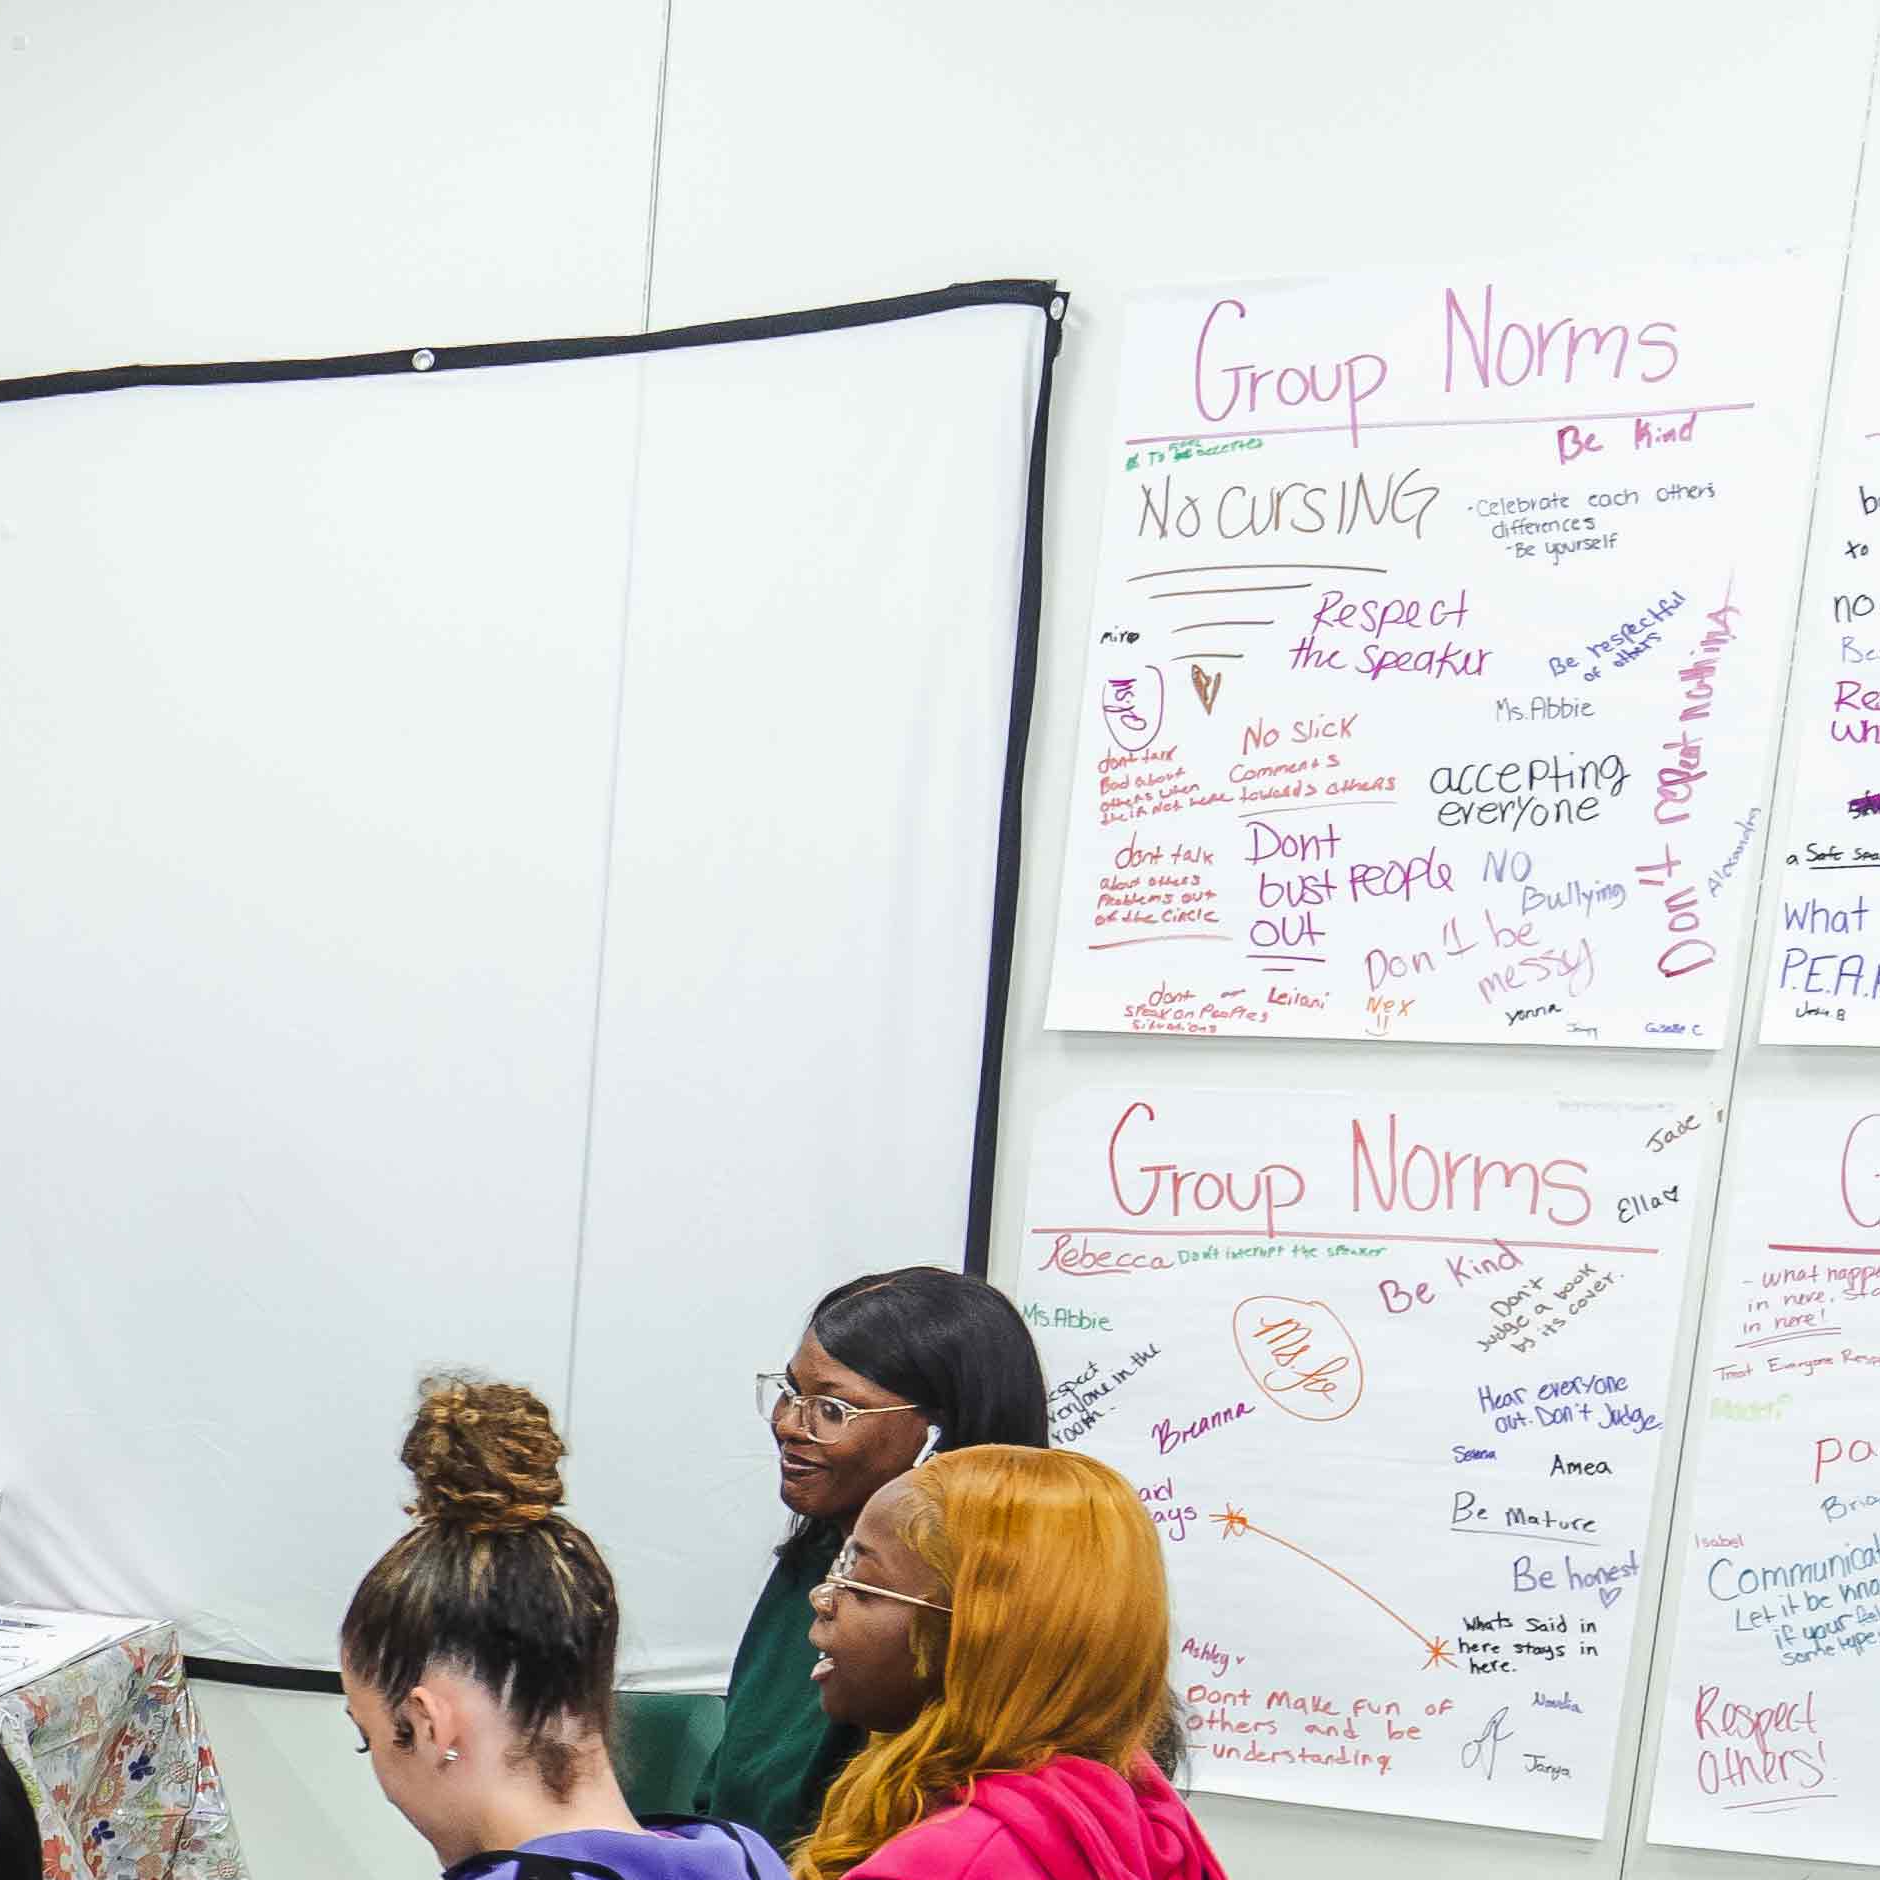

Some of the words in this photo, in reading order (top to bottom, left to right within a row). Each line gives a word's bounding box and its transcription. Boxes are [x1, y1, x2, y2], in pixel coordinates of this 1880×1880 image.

[1196, 299, 1388, 449] Group
[1444, 283, 1679, 392] Norms
[1556, 424, 1604, 465] Be
[1587, 488, 1640, 508] each
[1491, 516, 1596, 539] differences
[1544, 532, 1618, 564] yourself
[1311, 588, 1469, 640] Respect
[1547, 654, 1580, 678] Be
[1585, 589, 1687, 658] respectful
[1288, 635, 1348, 671] the
[1583, 666, 1602, 683] of
[1612, 630, 1662, 669] others
[1436, 796, 1602, 832] everyone
[1521, 880, 1627, 915] Bullying
[1784, 895, 1869, 935] What
[1484, 908, 1541, 949] be
[1477, 936, 1598, 1005] messy
[1108, 1101, 1306, 1239] Group
[1351, 1113, 1592, 1227] Norms
[1616, 1195, 1663, 1224] Ella
[1037, 1233, 1174, 1274] Rebecca
[1377, 1278, 1436, 1314] Be
[1445, 1238, 1523, 1288] Kind
[1489, 1273, 1546, 1318] Don't
[1533, 1299, 1552, 1315] a
[1552, 1262, 1599, 1301] book
[1510, 1332, 1537, 1353] by
[1477, 1384, 1528, 1414] Hear
[1537, 1374, 1629, 1401] everyone
[1151, 1401, 1257, 1456] Breanna
[1534, 1402, 1594, 1427] Don't
[1549, 1453, 1613, 1477] Amea
[1451, 1490, 1489, 1524] Be
[1513, 1555, 1558, 1593] Be
[1565, 1549, 1641, 1591] honest
[1579, 1618, 1598, 1634] in
[1181, 1636, 1230, 1679] Ashley
[1457, 1636, 1502, 1655] here
[1512, 1641, 1567, 1661] stays
[1579, 1641, 1599, 1657] in
[1303, 1717, 1362, 1741] and
[1386, 1719, 1423, 1742] be
[1695, 1684, 1819, 1752] Respect
